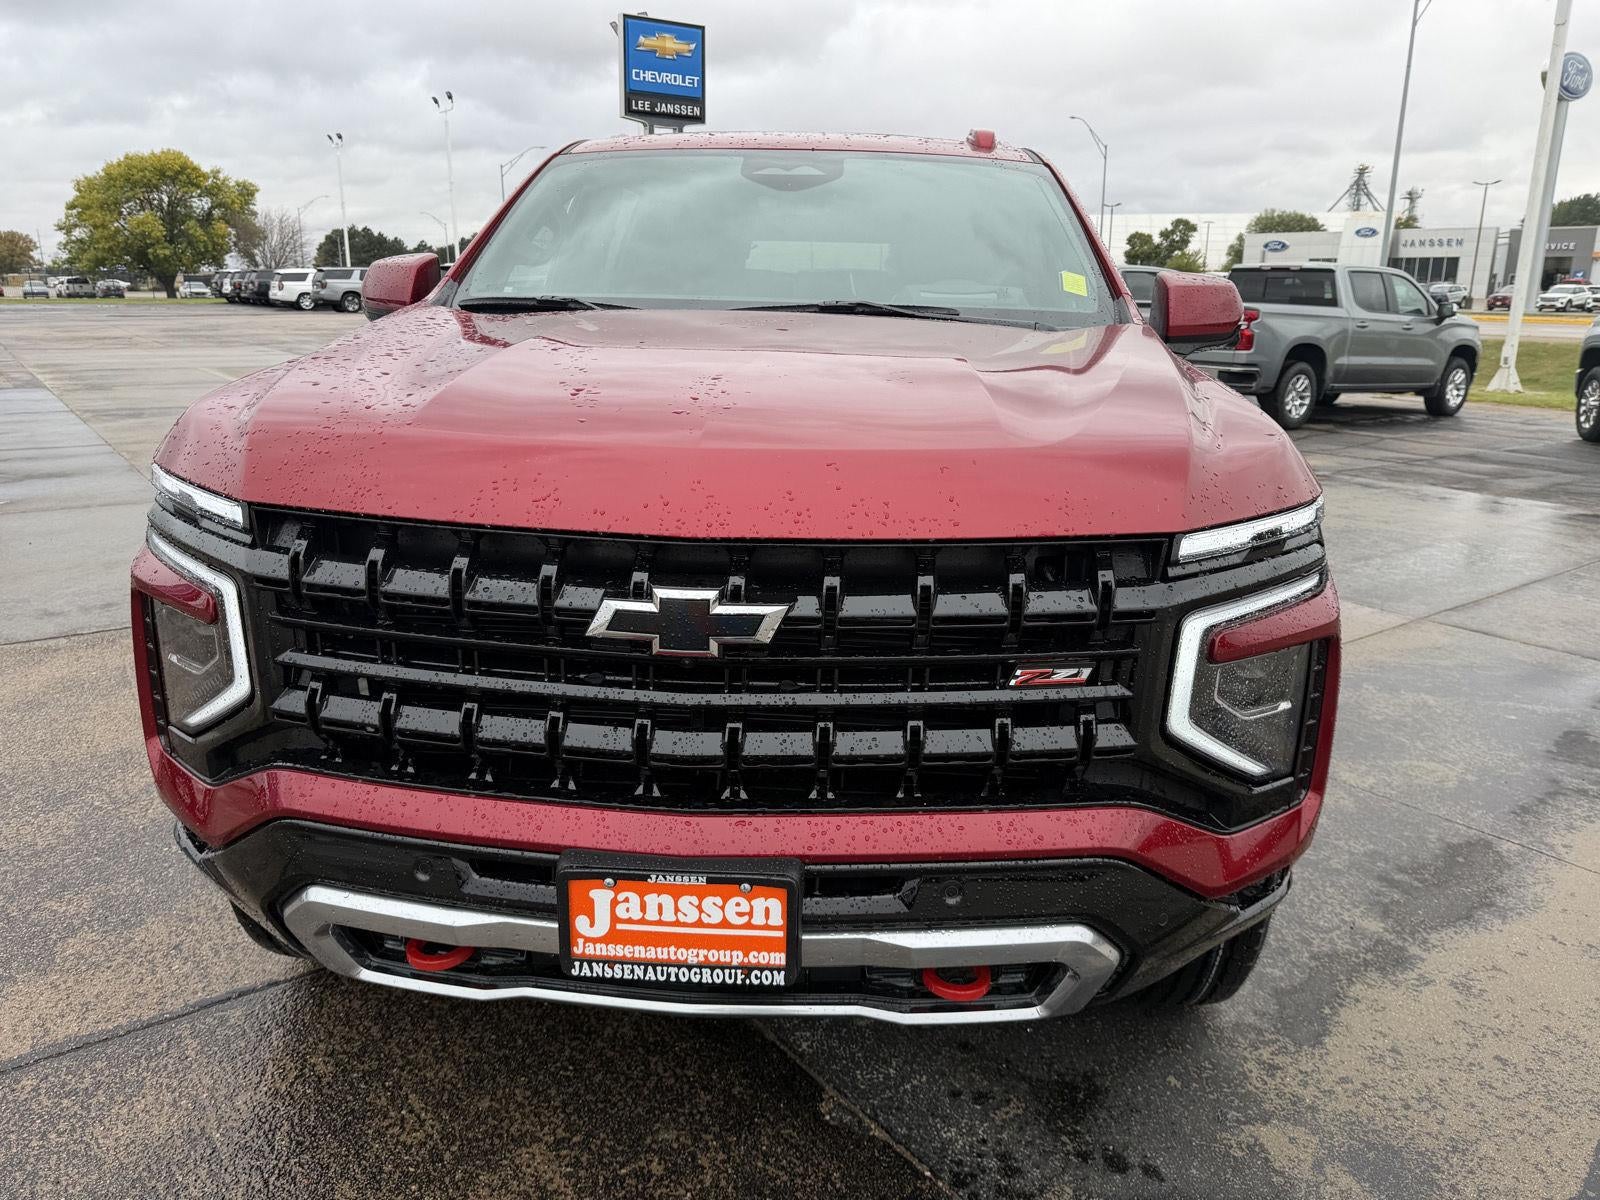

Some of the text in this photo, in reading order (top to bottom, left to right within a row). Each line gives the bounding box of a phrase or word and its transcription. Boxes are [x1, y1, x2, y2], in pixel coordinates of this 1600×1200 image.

[632, 69, 699, 87] CHEVROLET
[1563, 59, 1588, 89] Ford
[632, 100, 700, 116] LEE JANSSEN
[1401, 238, 1464, 248] JANSSEN
[1009, 668, 1092, 685] Z71
[647, 874, 707, 884] JANSSEN
[575, 889, 783, 937] Janssen
[573, 938, 785, 965] Janssenautogroup.com
[571, 961, 785, 986] JANSSENAUTOGROUP.COM
